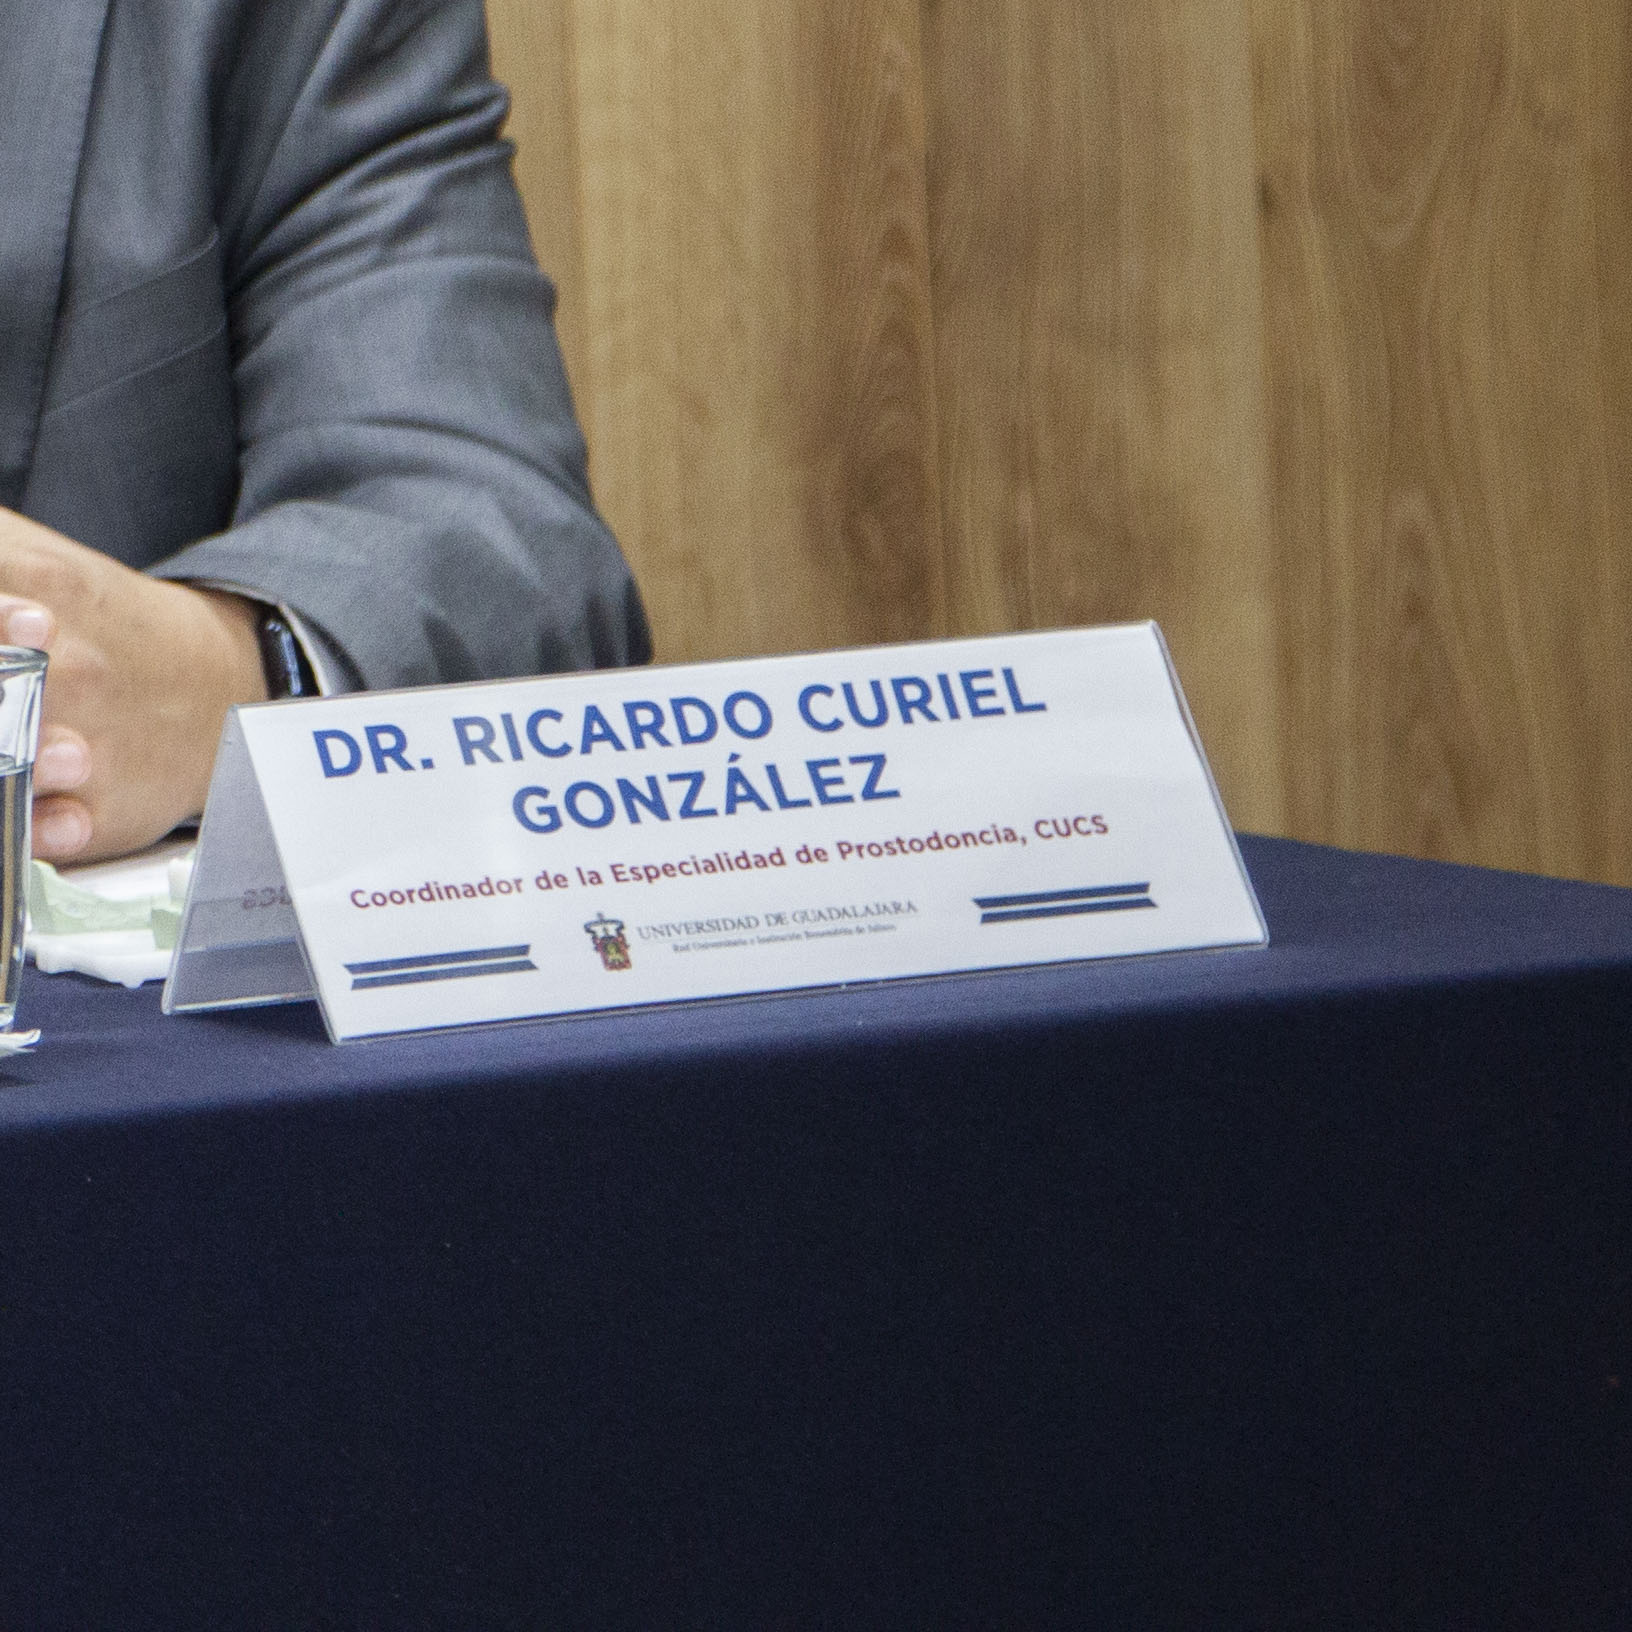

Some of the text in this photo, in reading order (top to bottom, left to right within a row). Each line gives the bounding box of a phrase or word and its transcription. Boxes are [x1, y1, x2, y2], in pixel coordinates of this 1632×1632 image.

[312, 667, 1047, 778] DR. RICARDO CURIEL
[512, 752, 901, 834] GONZÁLEZ
[350, 815, 1108, 909] Coordinador de la Especialidad de Prostodoncia, CUCS
[638, 901, 917, 939] UNIVERSIDAD DE GUADALAJARA
